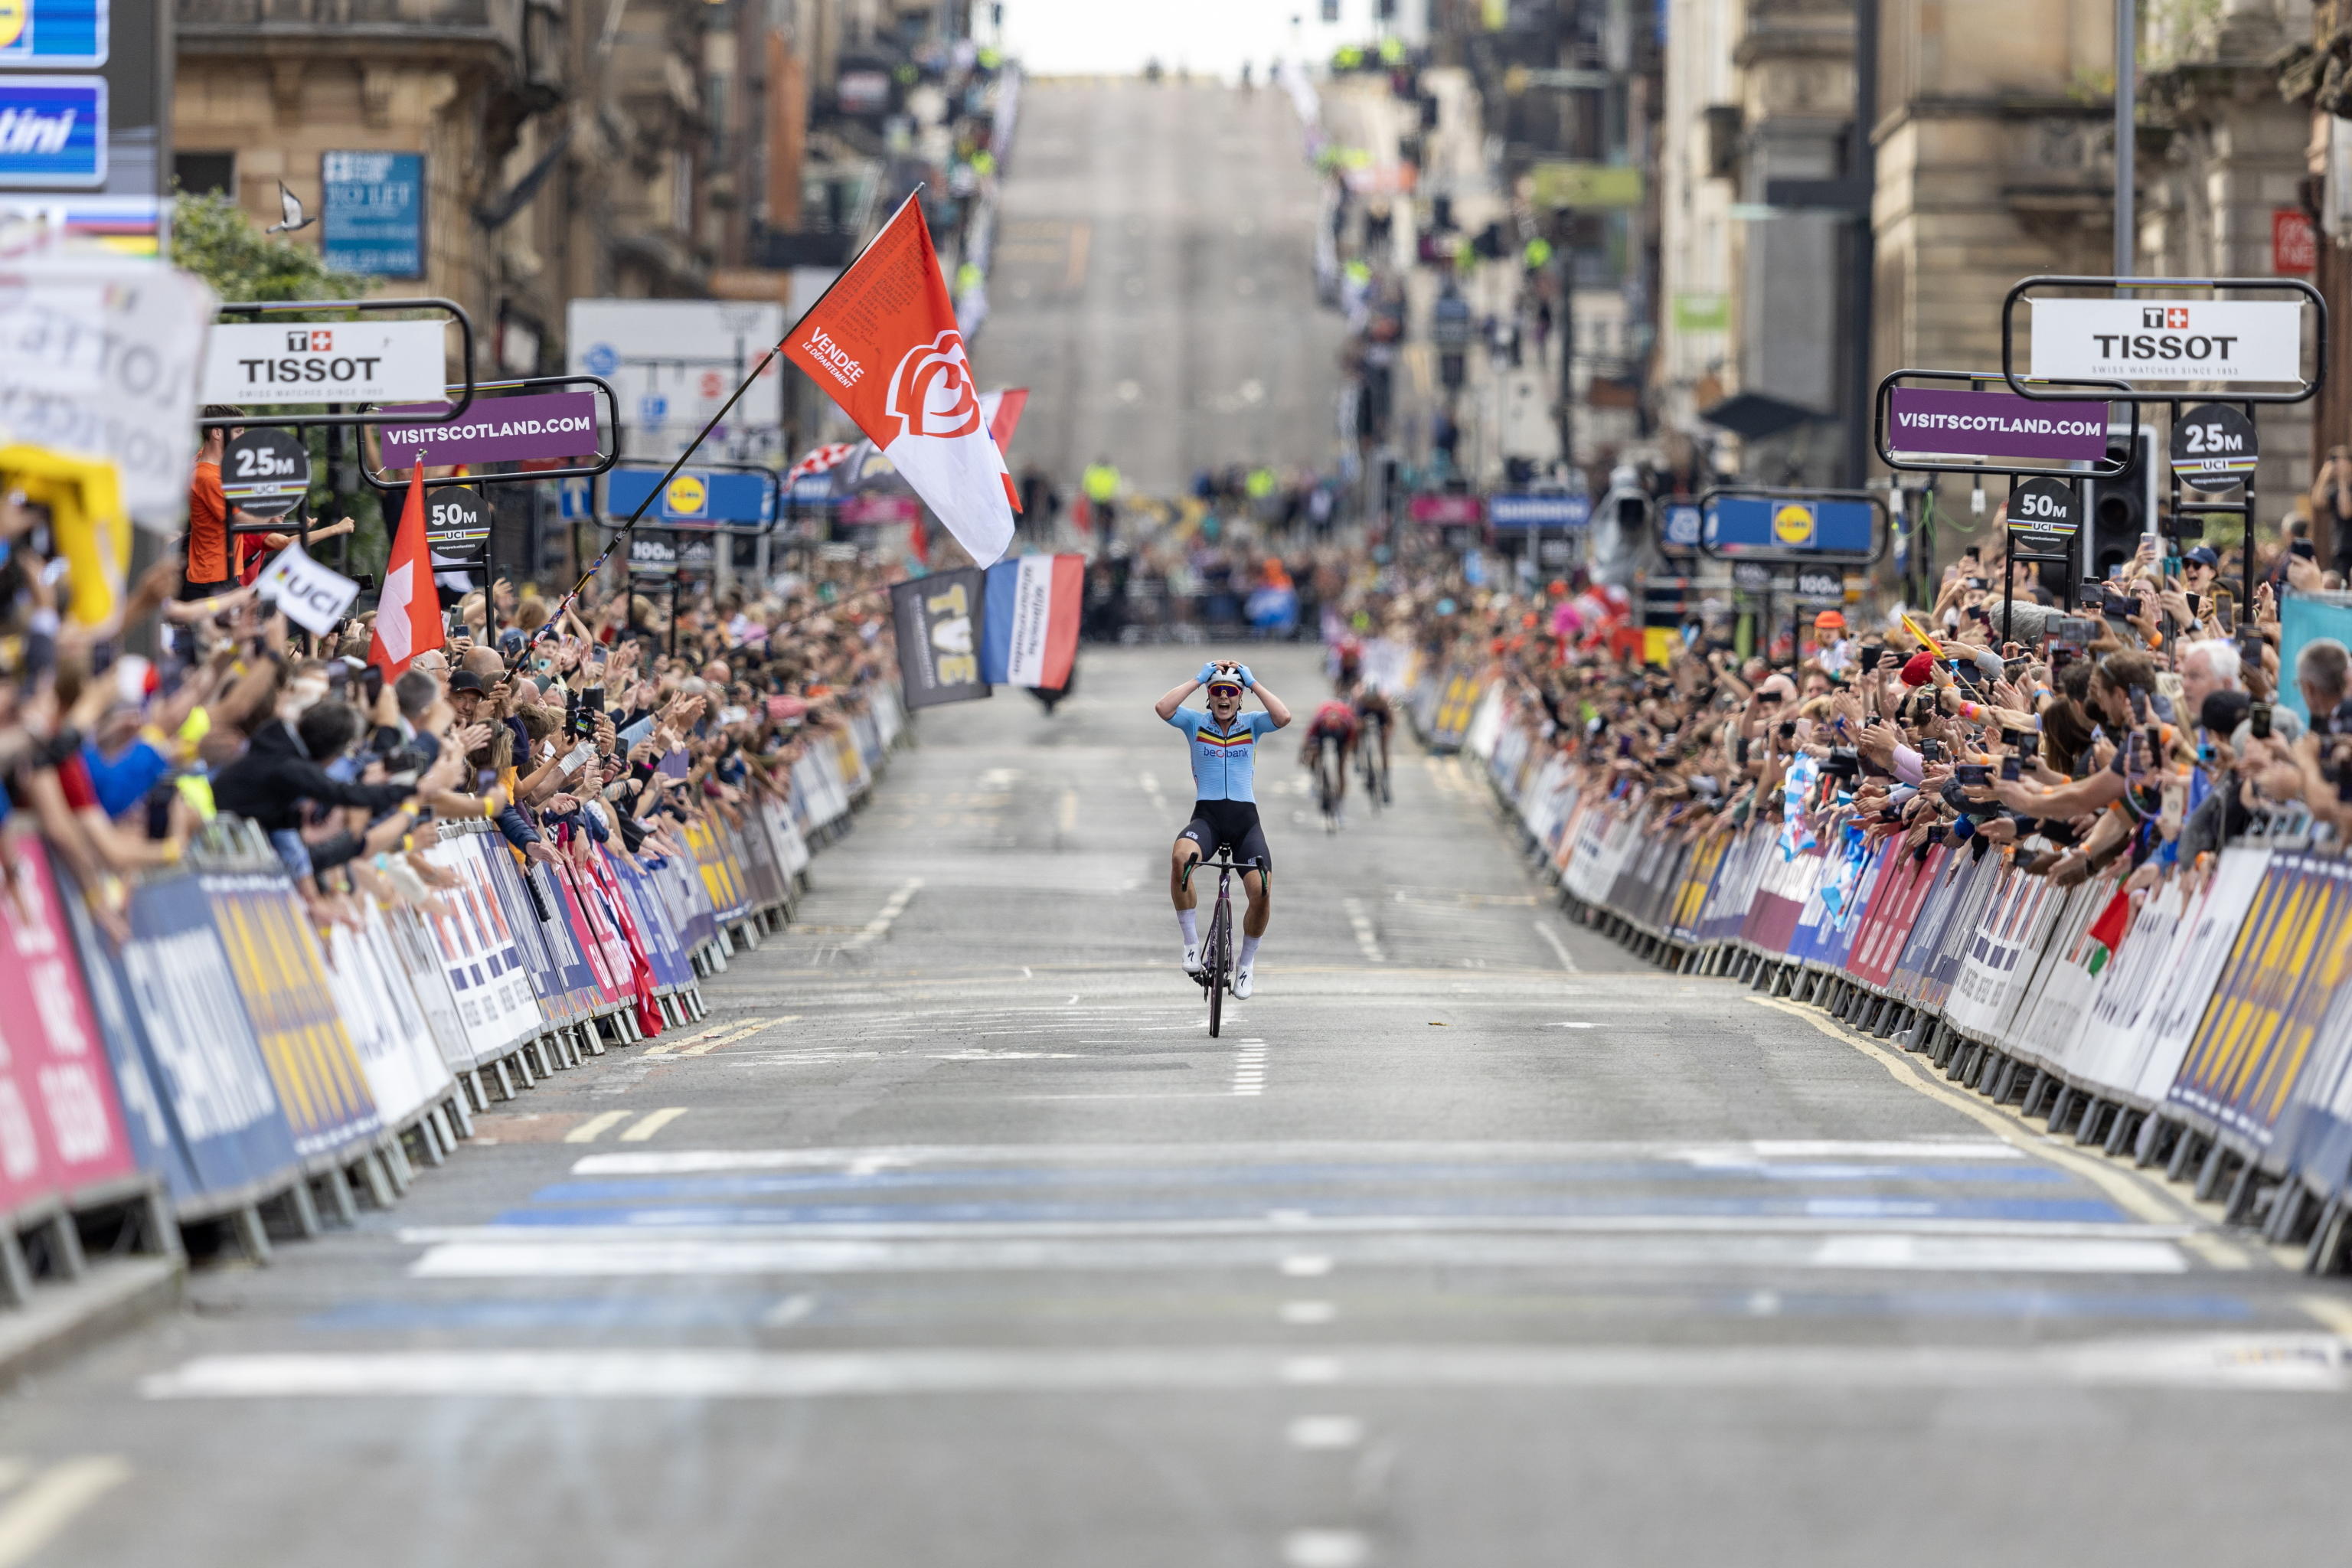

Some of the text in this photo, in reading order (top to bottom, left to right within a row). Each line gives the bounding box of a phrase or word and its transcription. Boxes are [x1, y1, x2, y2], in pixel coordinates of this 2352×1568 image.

[810, 326, 864, 383] VENDÉE
[2093, 335, 2238, 360] TISSOT
[239, 357, 381, 384] TISSOT
[802, 341, 854, 389] LE DÉPARTEMENT
[2092, 365, 2125, 374] SWISS
[2129, 365, 2176, 374] WATCHES
[2181, 366, 2212, 375] SINCE
[238, 390, 271, 399] SWISS
[276, 389, 322, 397] WATCHES
[326, 388, 357, 397] SINCE
[387, 416, 590, 445] VISITSCOTLAND.COM
[1899, 413, 2101, 437] VISITSCOTLAND.COM
[2185, 423, 2243, 453] 25M
[235, 447, 295, 477] 25M
[2203, 460, 2226, 471] UCI
[432, 503, 477, 526] 50M
[2021, 494, 2067, 518] 50M
[446, 531, 465, 540] UCI
[2034, 523, 2052, 531] UCI
[287, 574, 342, 617] UCI
[926, 583, 978, 687] TVE
